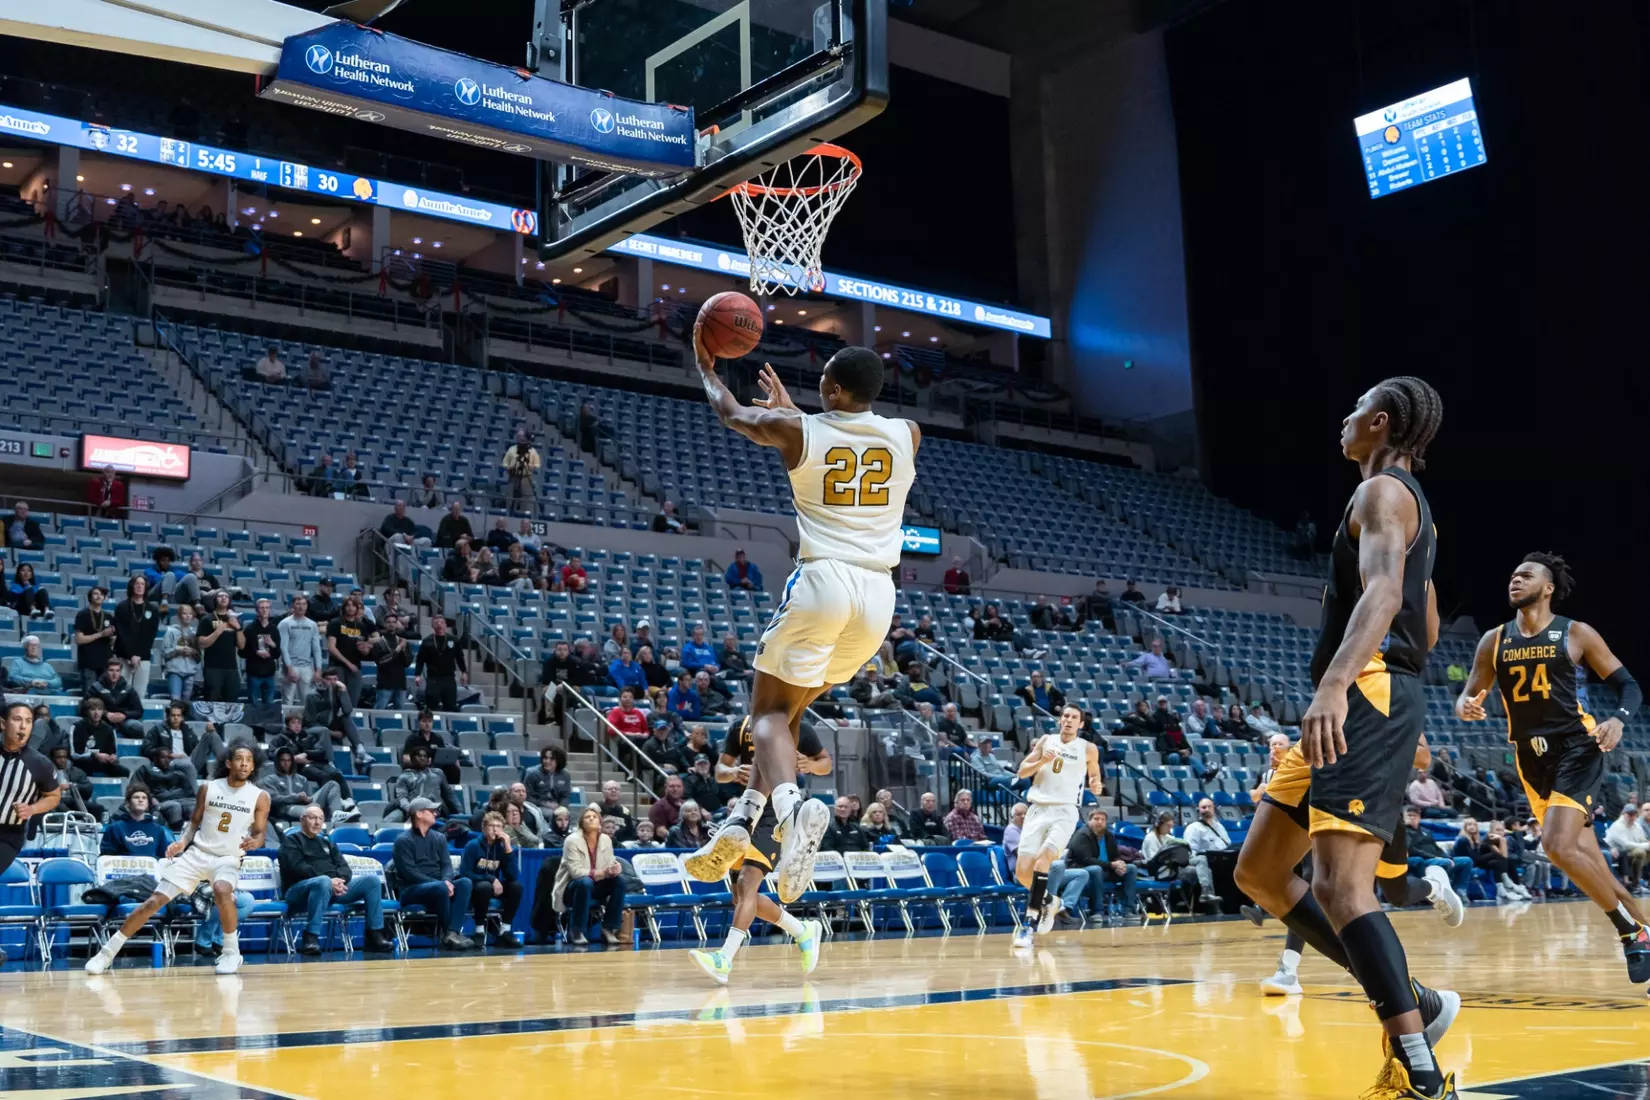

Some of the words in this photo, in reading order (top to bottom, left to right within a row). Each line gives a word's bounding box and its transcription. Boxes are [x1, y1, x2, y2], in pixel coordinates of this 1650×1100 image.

[335, 51, 390, 74] Lutheran
[335, 66, 369, 83] Health
[370, 74, 415, 93] Network
[482, 84, 532, 105] Lutheran
[482, 98, 514, 113] Health
[515, 105, 556, 122] Network
[615, 112, 664, 130] Lutheran
[1403, 117, 1423, 131] TEAM
[1423, 110, 1446, 124] STATS
[117, 134, 138, 153] 32
[616, 126, 647, 139] Health
[648, 131, 687, 145] Network
[178, 144, 185, 152] 2
[178, 155, 184, 164] 4
[198, 149, 236, 172] 5:45
[255, 158, 261, 169] 1
[251, 170, 268, 181] HALF
[284, 165, 291, 175] 5
[285, 176, 291, 186] 3
[318, 174, 338, 192] 30
[628, 239, 657, 254] SECRET
[838, 279, 898, 303] SECTIONS
[901, 292, 924, 308] 215
[926, 296, 936, 311] &
[939, 299, 961, 315] 218
[0, 441, 20, 453] 213
[823, 446, 893, 506] 22
[1503, 645, 1556, 662] COMMERCE
[1509, 663, 1551, 702] 24
[1052, 757, 1064, 774] 0
[209, 801, 251, 814] MASTODONS
[218, 811, 232, 832] 2
